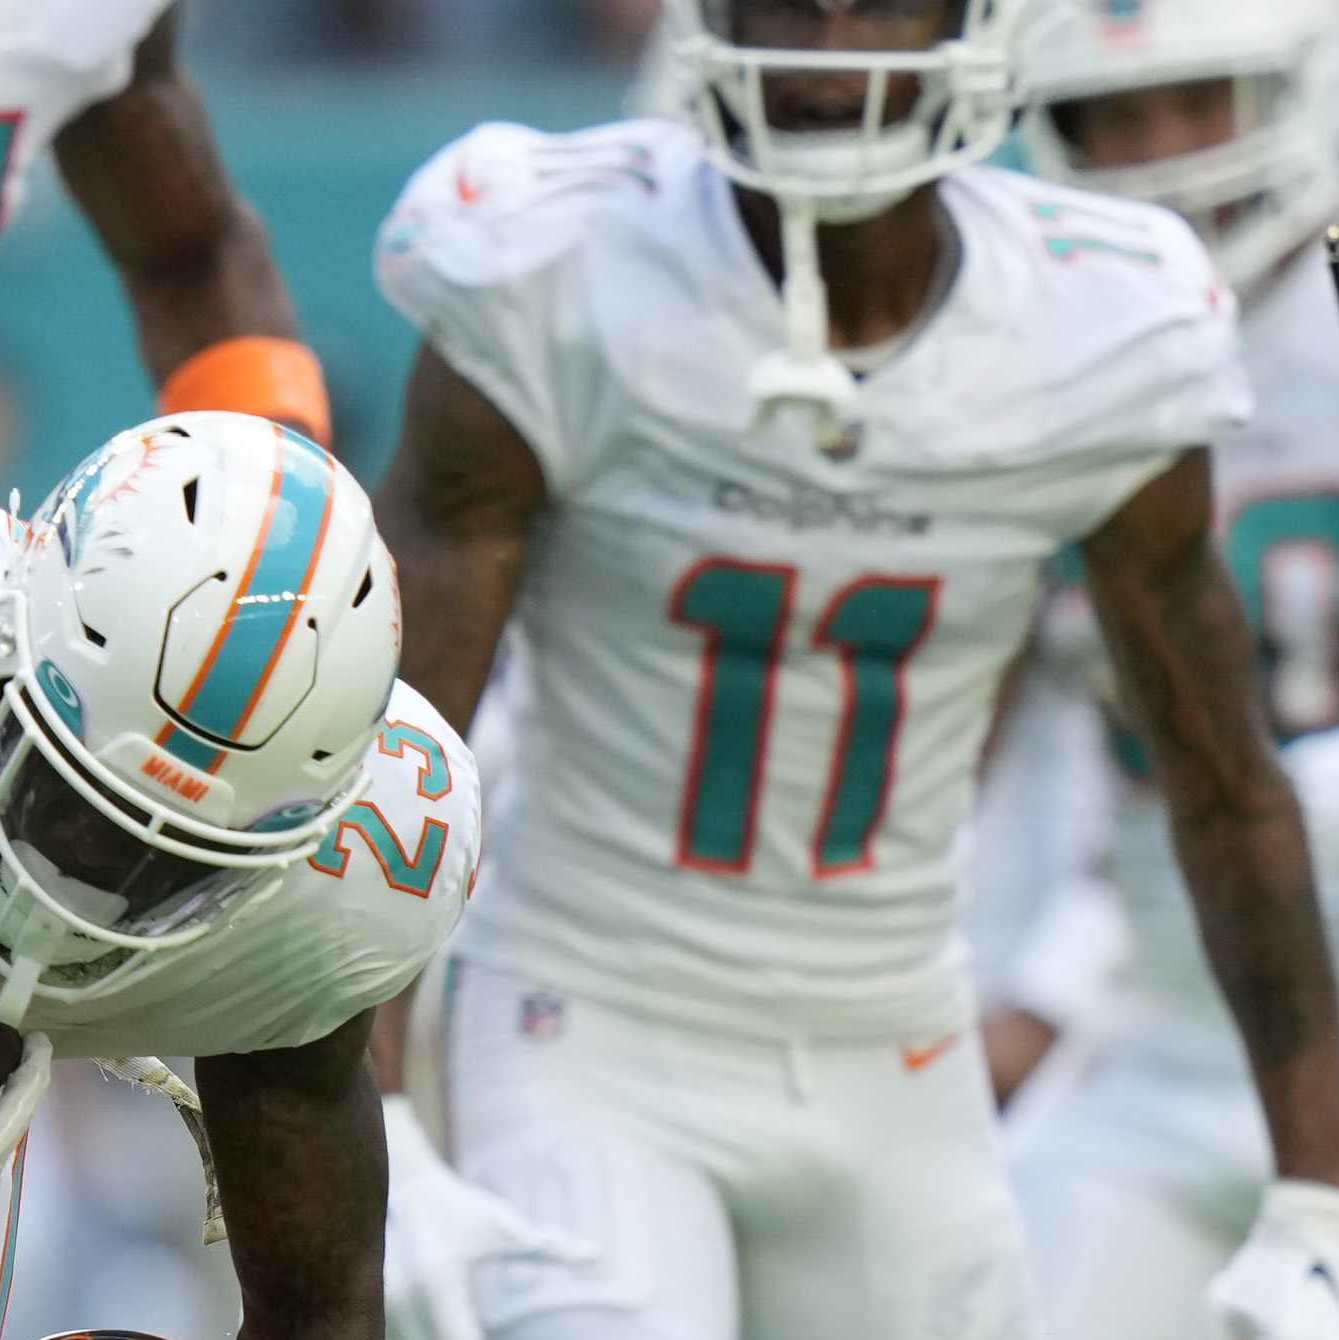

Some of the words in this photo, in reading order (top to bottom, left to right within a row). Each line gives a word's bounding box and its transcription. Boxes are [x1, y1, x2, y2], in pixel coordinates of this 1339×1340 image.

[140, 753, 210, 804] MIAMI
[306, 716, 453, 899] 23
[670, 555, 942, 880] 11
